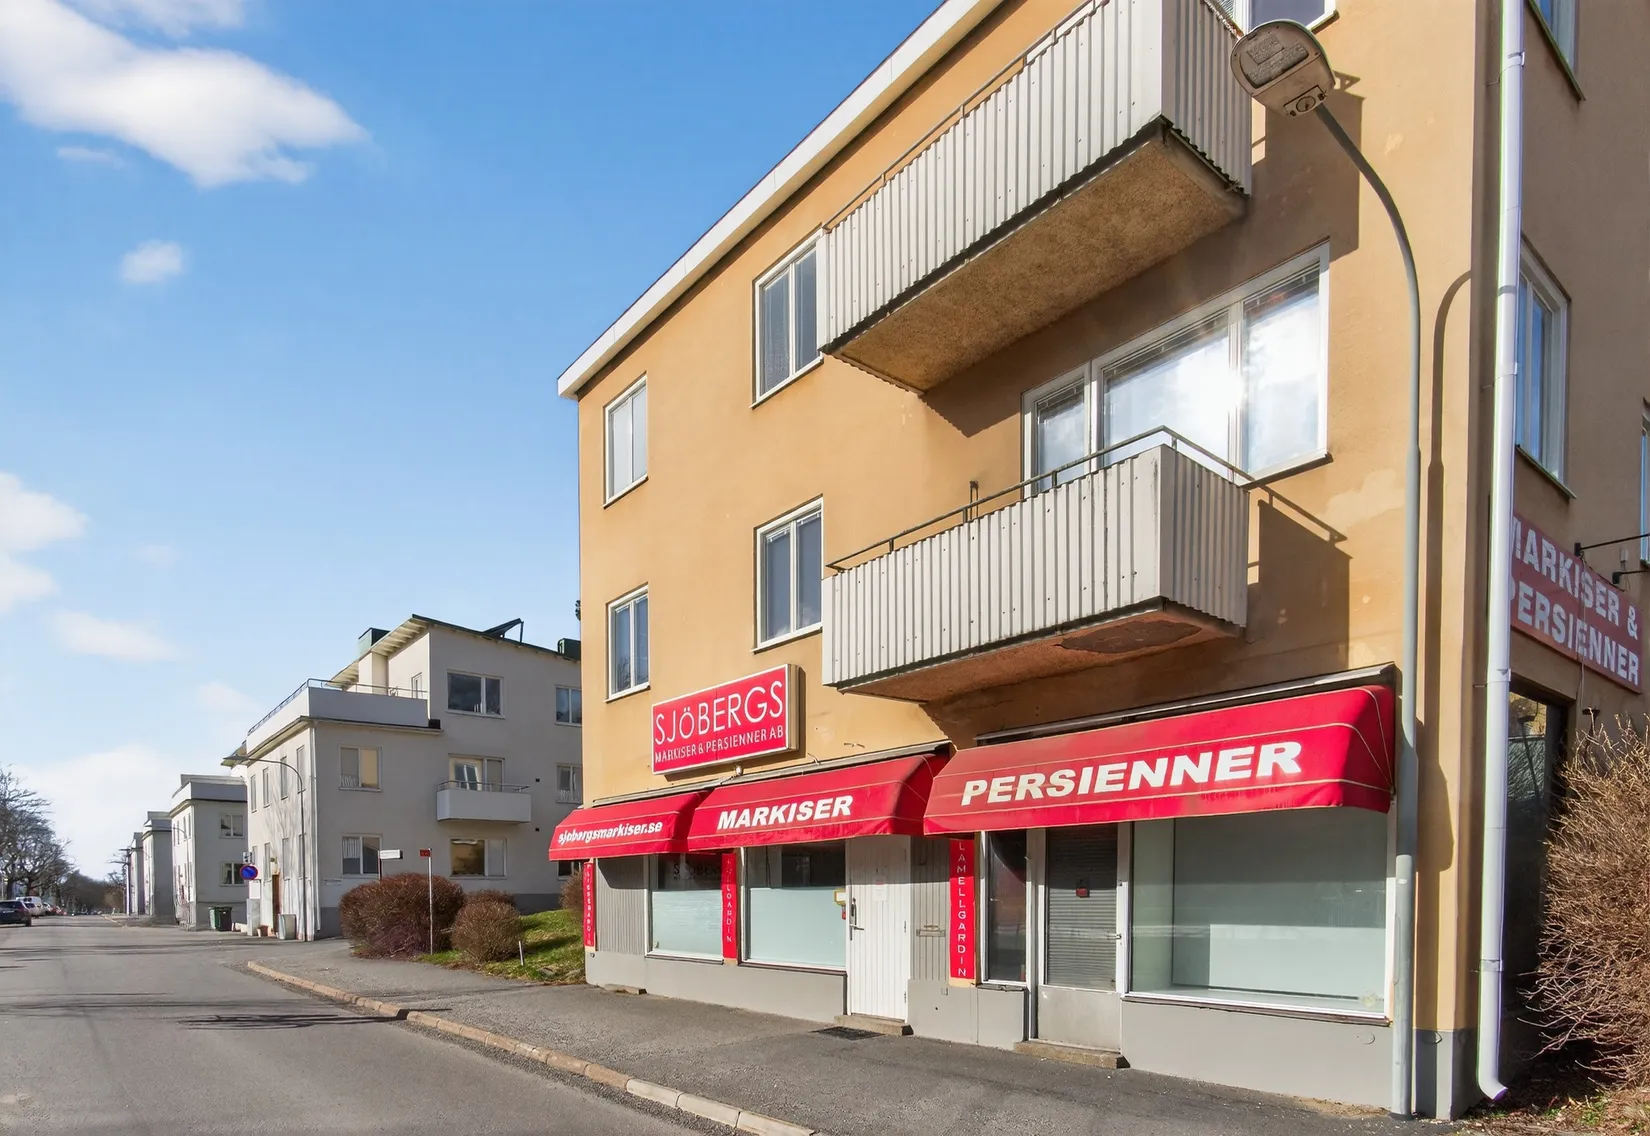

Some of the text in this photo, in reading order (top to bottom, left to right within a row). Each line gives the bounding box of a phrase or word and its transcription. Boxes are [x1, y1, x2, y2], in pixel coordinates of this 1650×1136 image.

[1627, 605, 1639, 640] &
[655, 680, 783, 745] SJÖBERGS
[655, 725, 784, 763] MARKISER & PERSIENNER AB
[960, 741, 1302, 806] PERSIENNER
[717, 795, 854, 830] MARKISER
[956, 841, 967, 977] LAMELLGARDIN
